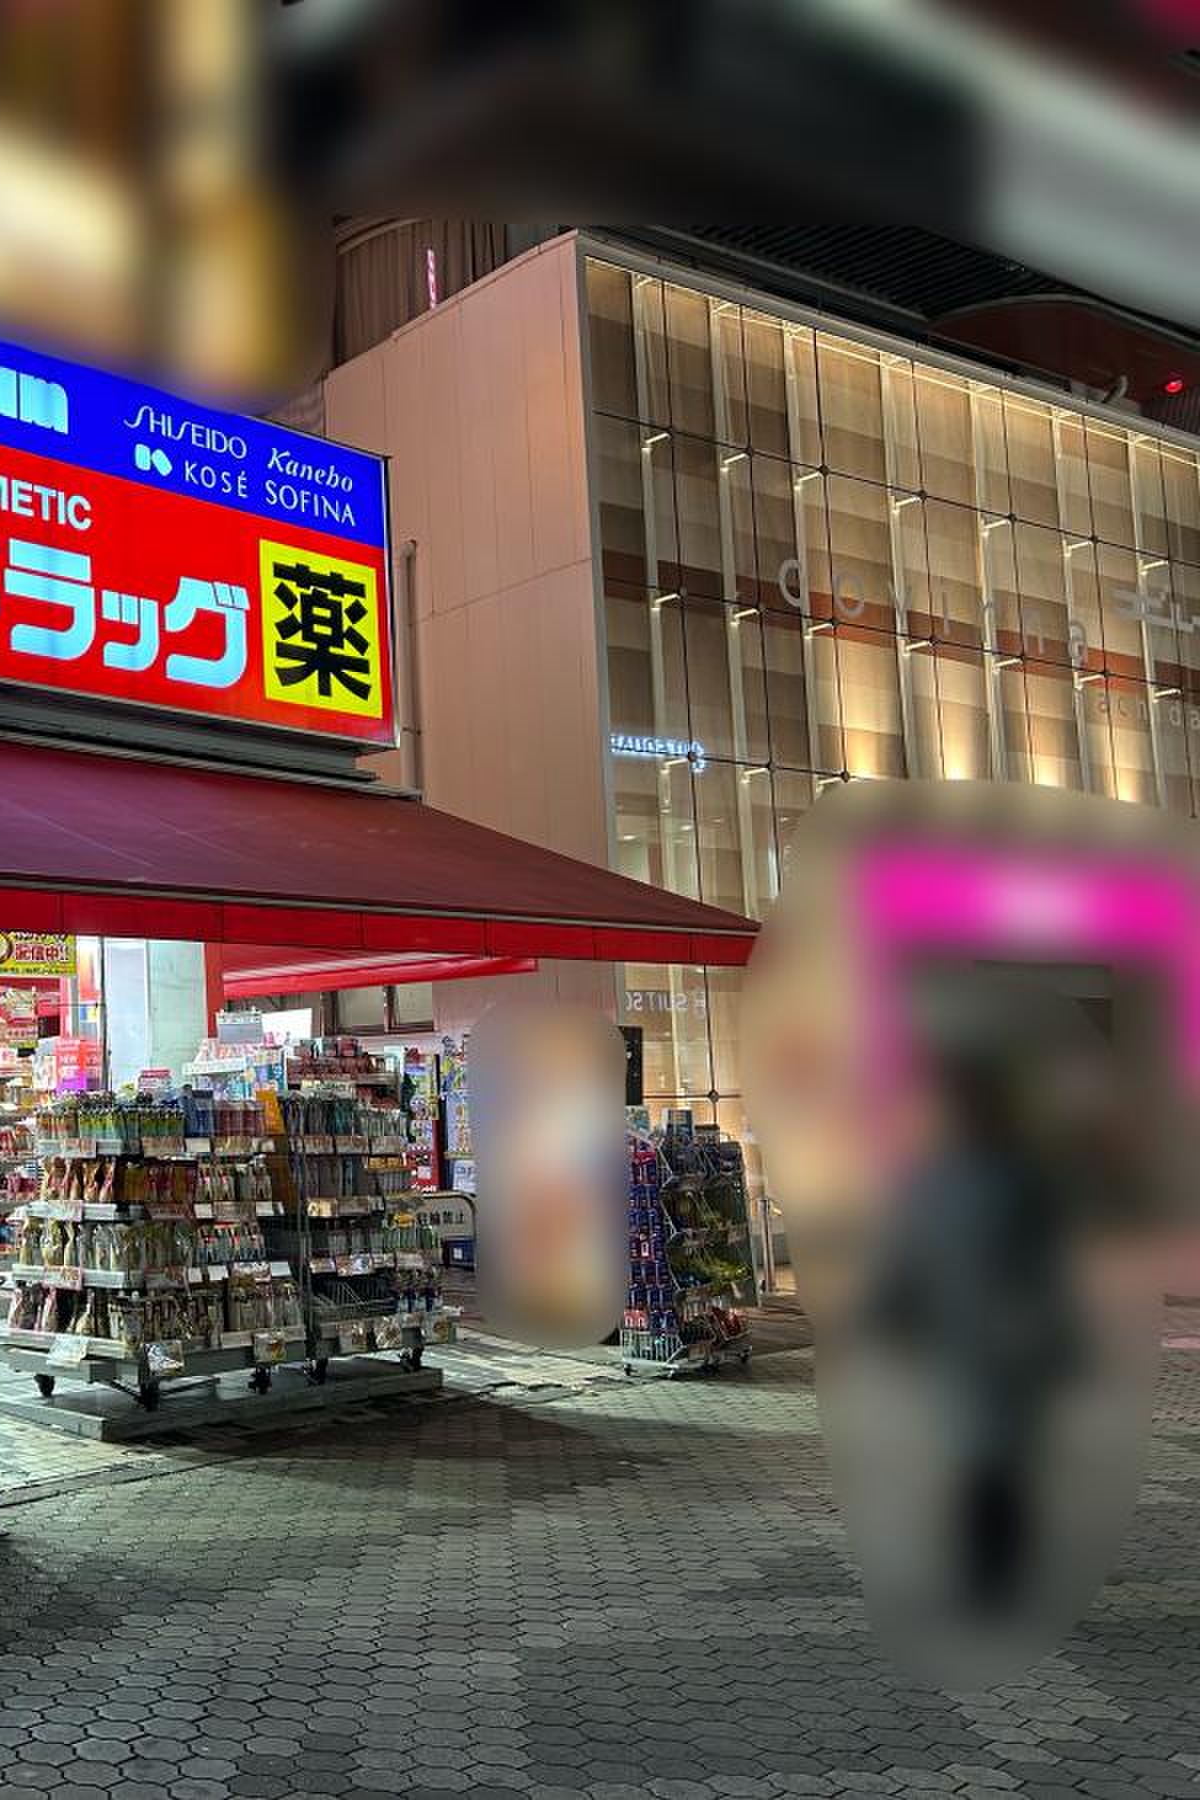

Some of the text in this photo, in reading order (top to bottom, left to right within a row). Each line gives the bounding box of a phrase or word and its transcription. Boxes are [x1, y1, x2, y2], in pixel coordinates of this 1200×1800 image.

[124, 405, 355, 494] SHISEIDO Kanebo
[184, 466, 356, 527] KOSÉ SOFINA
[272, 561, 373, 701] 薬
